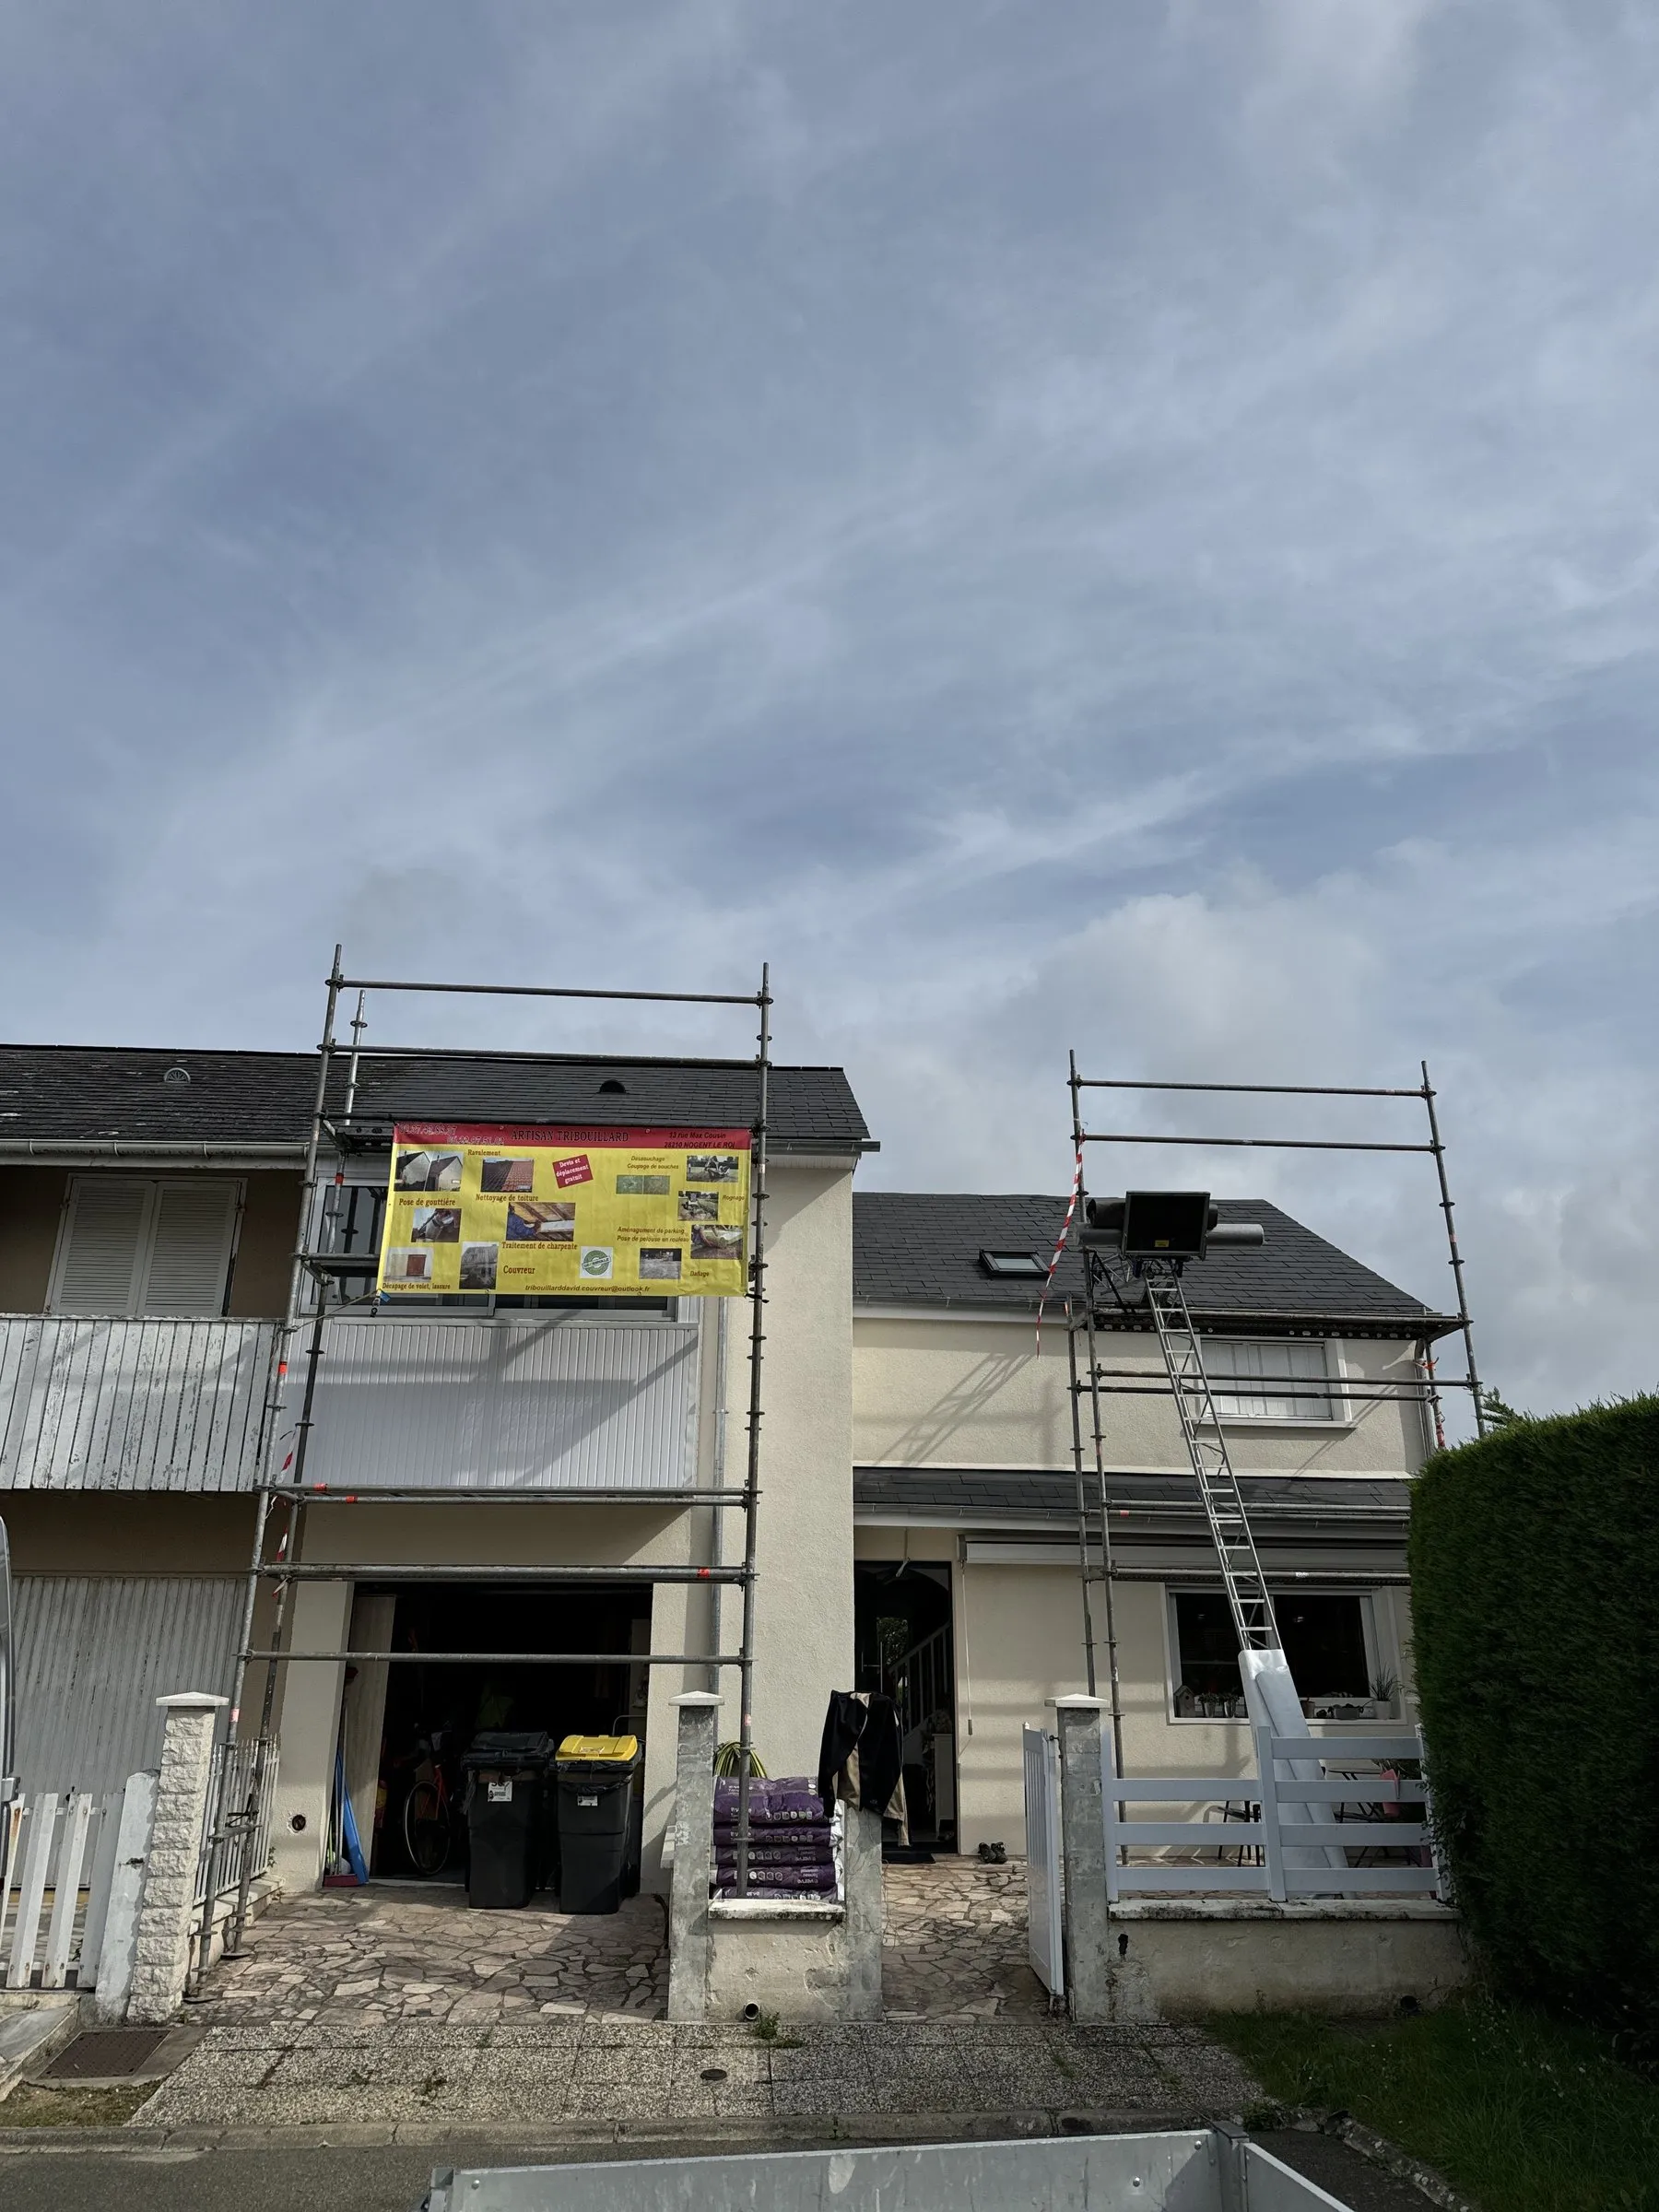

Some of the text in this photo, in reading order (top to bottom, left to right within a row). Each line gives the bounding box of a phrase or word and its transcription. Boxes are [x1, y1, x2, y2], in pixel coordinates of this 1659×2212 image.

[512, 1130, 629, 1142] ARTISAN TRIBOUILLARD
[704, 1131, 726, 1139] Cousin
[559, 1159, 573, 1168] Devis
[556, 1164, 589, 1178] déplacement
[565, 1174, 582, 1184] gratuit
[426, 1198, 455, 1207] gouttière
[476, 1194, 539, 1203] Nettoyage de toiture
[502, 1241, 578, 1252] Traitement de charpente
[503, 1265, 535, 1275] Couvreur
[382, 1282, 407, 1290] Décapage
[416, 1282, 430, 1290] volet,
[525, 1285, 650, 1293] tribouillarddavid.couvreur@outlook.fr
